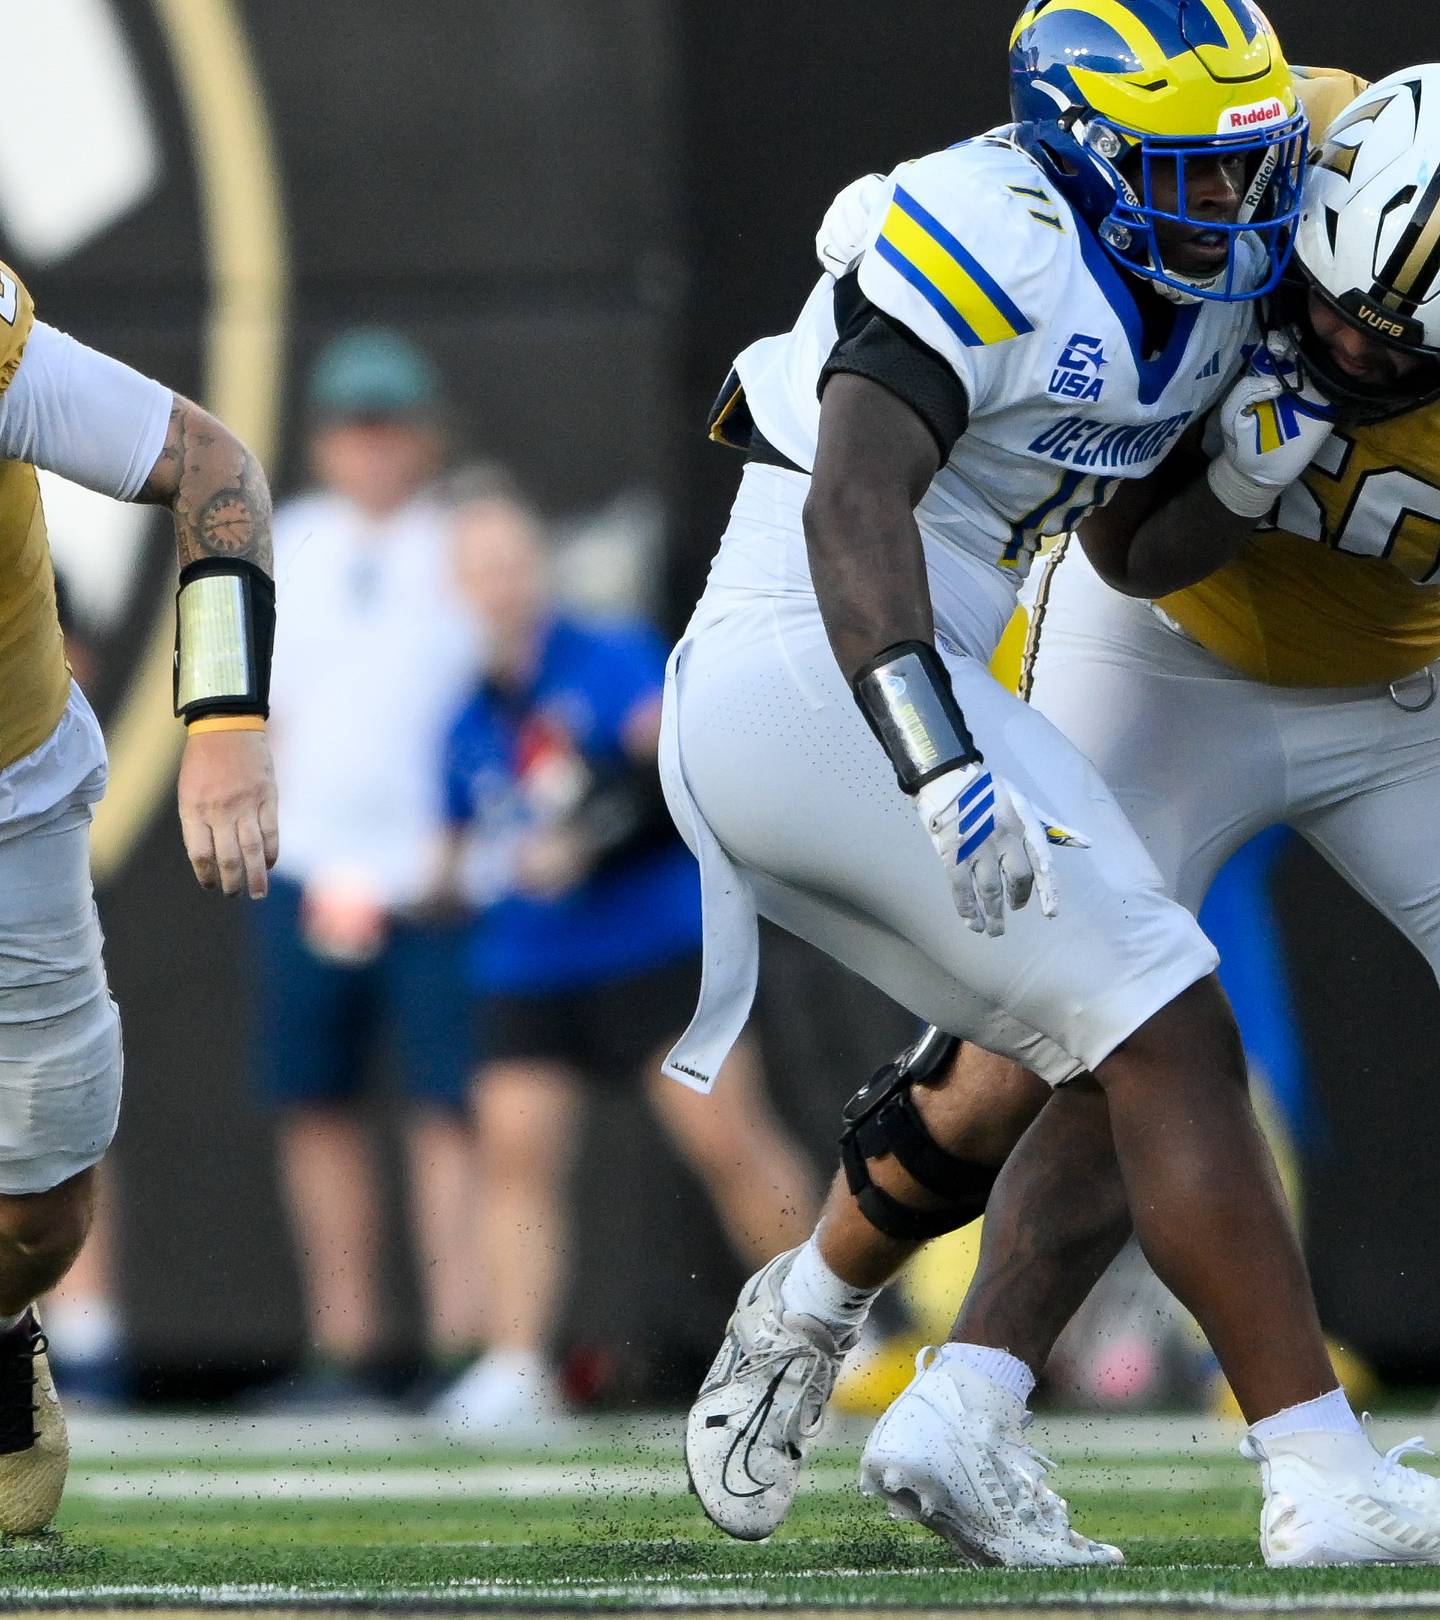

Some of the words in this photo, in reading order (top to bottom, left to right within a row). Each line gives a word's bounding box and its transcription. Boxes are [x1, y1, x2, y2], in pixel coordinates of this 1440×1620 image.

[1230, 103, 1281, 127] Riddell
[1245, 156, 1276, 207] Riddell
[1359, 305, 1404, 337] VUFB
[1047, 369, 1105, 402] USA
[1027, 411, 1193, 467] DELAWARE
